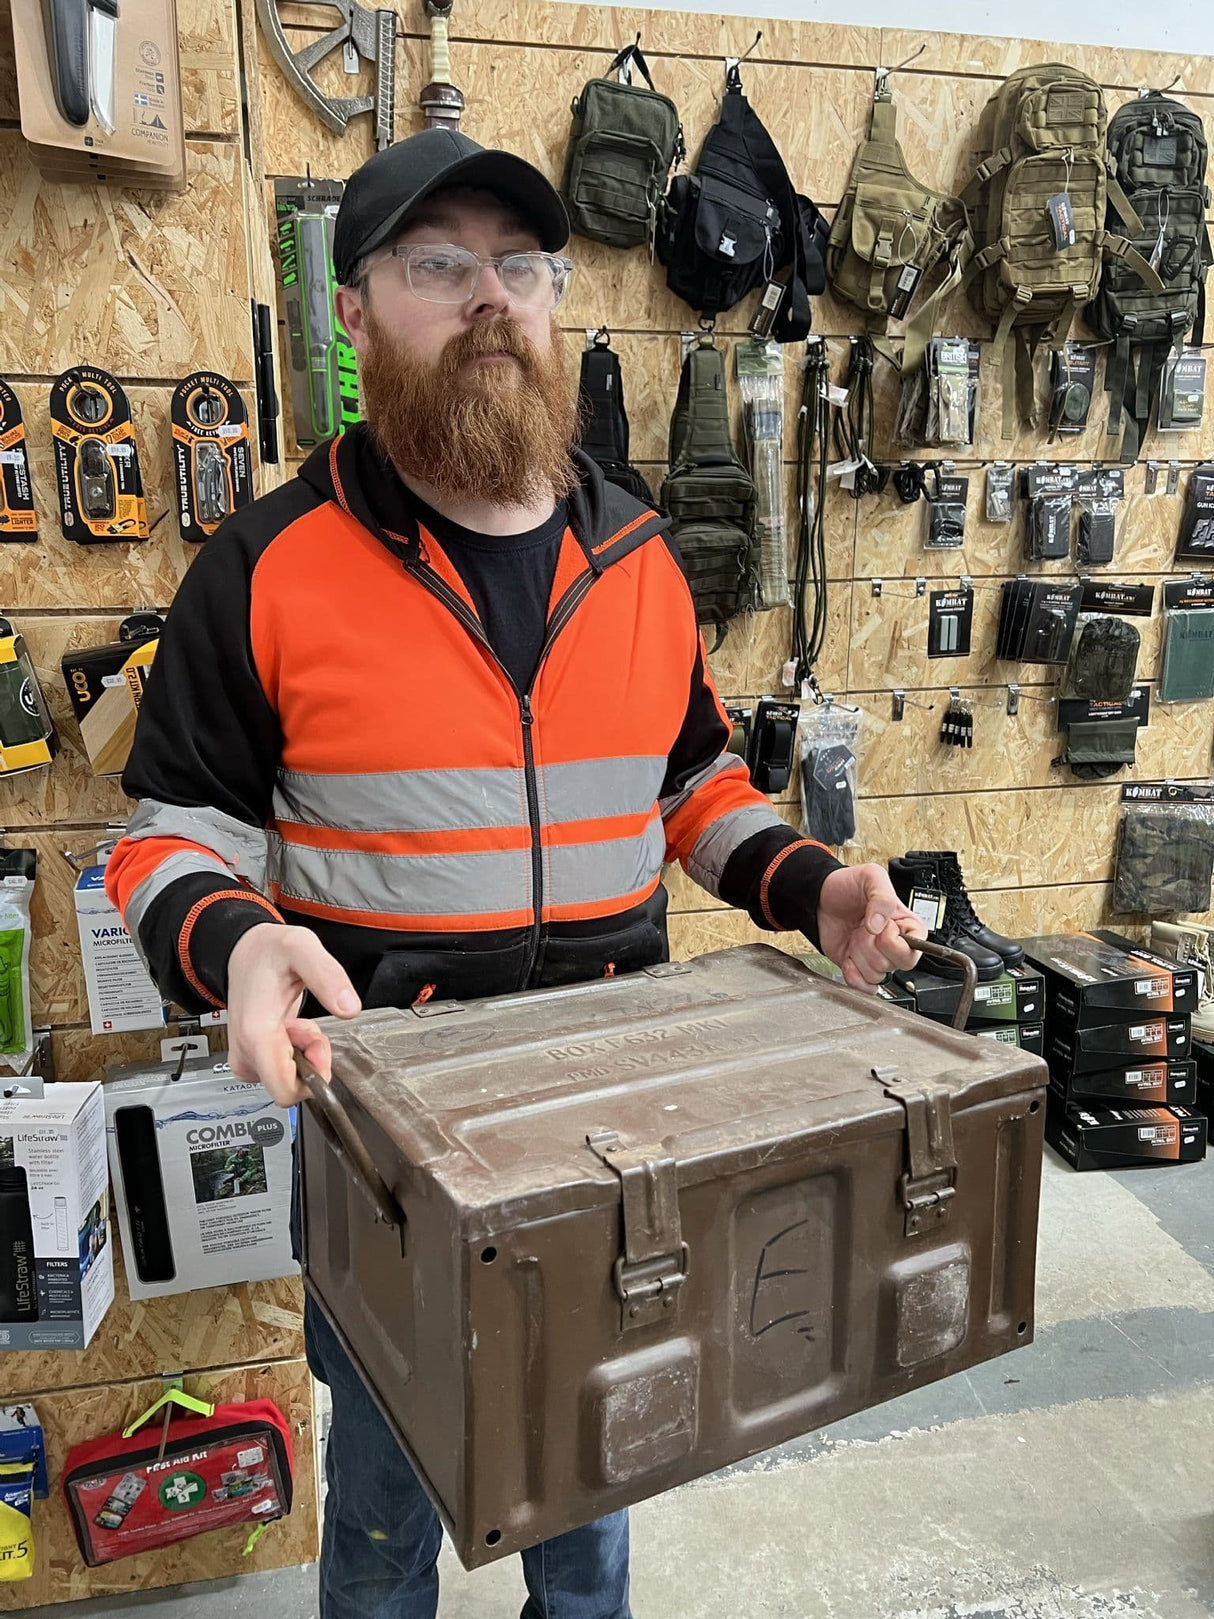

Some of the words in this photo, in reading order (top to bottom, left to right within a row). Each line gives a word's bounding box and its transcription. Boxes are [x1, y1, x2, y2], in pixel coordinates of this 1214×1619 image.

[131, 127, 169, 142] COMPANION
[82, 371, 102, 381] MULTI
[103, 379, 118, 394] TOOL
[179, 378, 198, 397] POCKET
[200, 376, 220, 386] MULTI
[220, 382, 234, 397] TOOL
[237, 446, 246, 478] SEVEN
[1186, 588, 1213, 596] KOMBAT
[936, 598, 968, 607] KOMBAT
[1125, 786, 1162, 798] KOMBAT
[547, 1042, 606, 1061] BOX
[256, 1121, 278, 1132] PLUS
[17, 1134, 58, 1143] LifeStraw
[188, 1139, 231, 1152] MICROFILTER
[16, 1255, 31, 1312] LifeStraw
[749, 1219, 809, 1338] E
[173, 1455, 190, 1465] Aid
[192, 1450, 209, 1461] Kit
